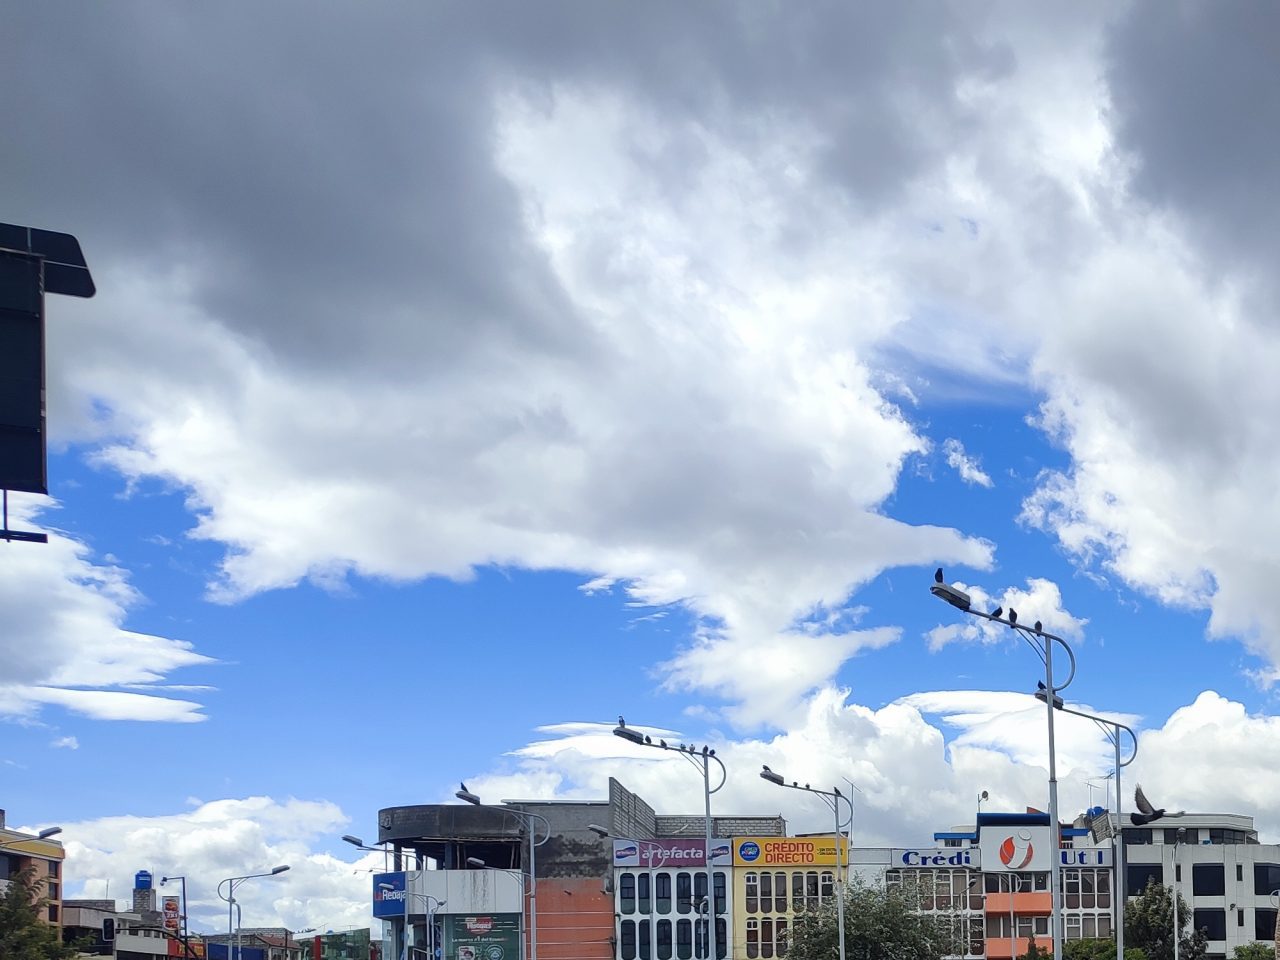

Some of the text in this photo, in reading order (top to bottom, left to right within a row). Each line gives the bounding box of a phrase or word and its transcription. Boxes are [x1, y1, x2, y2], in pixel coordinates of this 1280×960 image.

[642, 847, 703, 859] artefacta
[765, 841, 814, 853] CRÉDITO
[765, 853, 814, 863] DIRECTO
[902, 851, 971, 866] Crédi
